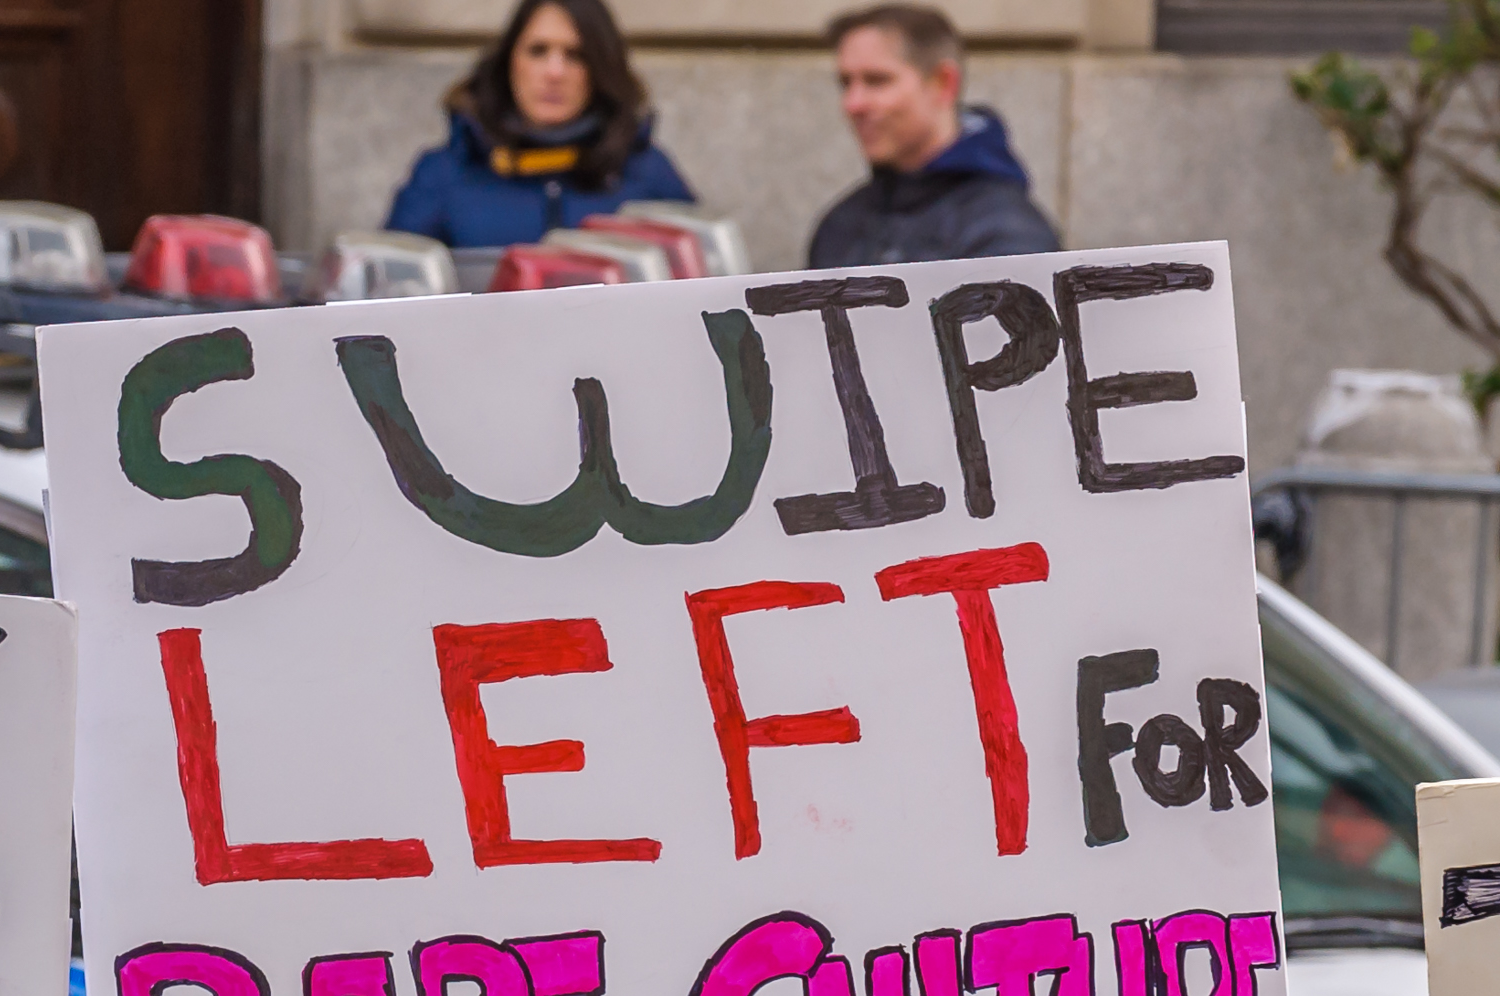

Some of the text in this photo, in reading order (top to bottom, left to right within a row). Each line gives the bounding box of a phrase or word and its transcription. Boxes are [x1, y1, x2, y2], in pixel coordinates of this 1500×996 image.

[117, 263, 1246, 606] SWIPE
[156, 541, 1270, 887] LEFT FOR
